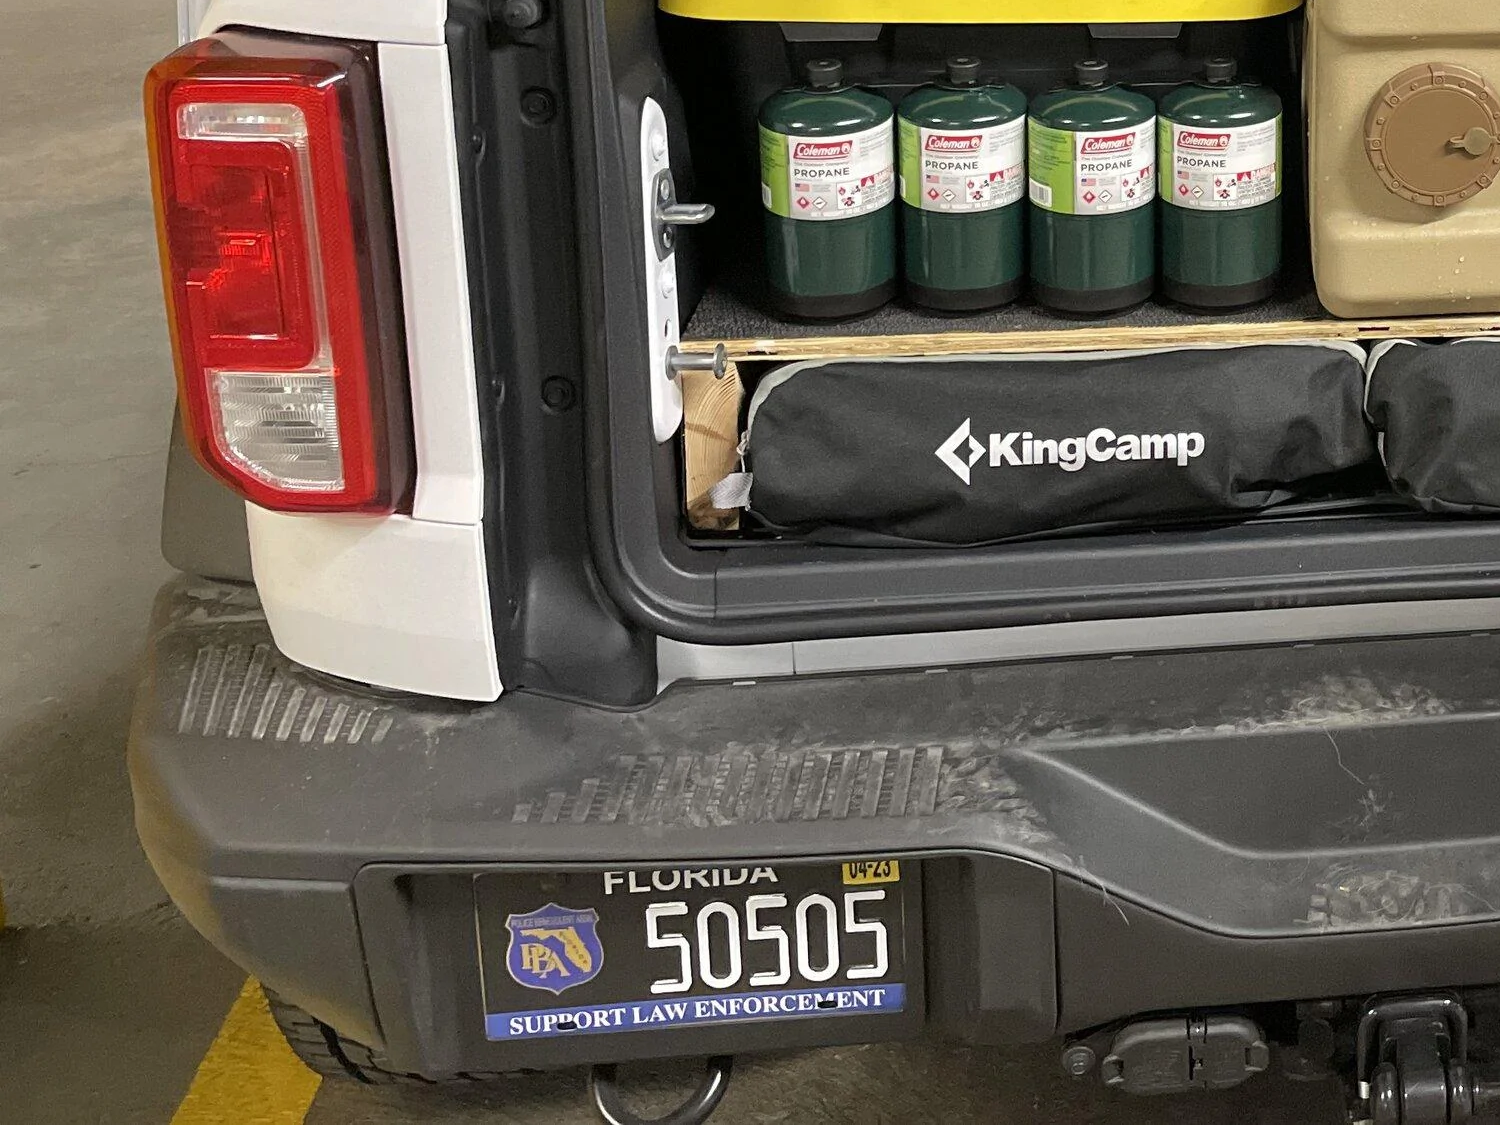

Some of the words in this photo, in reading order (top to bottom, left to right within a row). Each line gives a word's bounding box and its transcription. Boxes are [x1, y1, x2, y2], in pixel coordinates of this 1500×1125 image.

[928, 135, 970, 149] Coleman
[1084, 136, 1125, 151] Coleman
[1179, 131, 1219, 147] Coleman
[796, 142, 840, 157] Coleman
[925, 159, 979, 171] PROPANE
[1081, 159, 1132, 172] PROPANE
[1177, 155, 1227, 168] PROPANE
[794, 167, 850, 178] PROPANE
[988, 427, 1206, 472] KingCamp
[603, 866, 779, 895] FLORIDA
[645, 888, 889, 995] 50505
[508, 1007, 626, 1035] SUPPORT
[631, 1001, 688, 1024] LAW
[694, 988, 887, 1019] ENFORCEMENT
